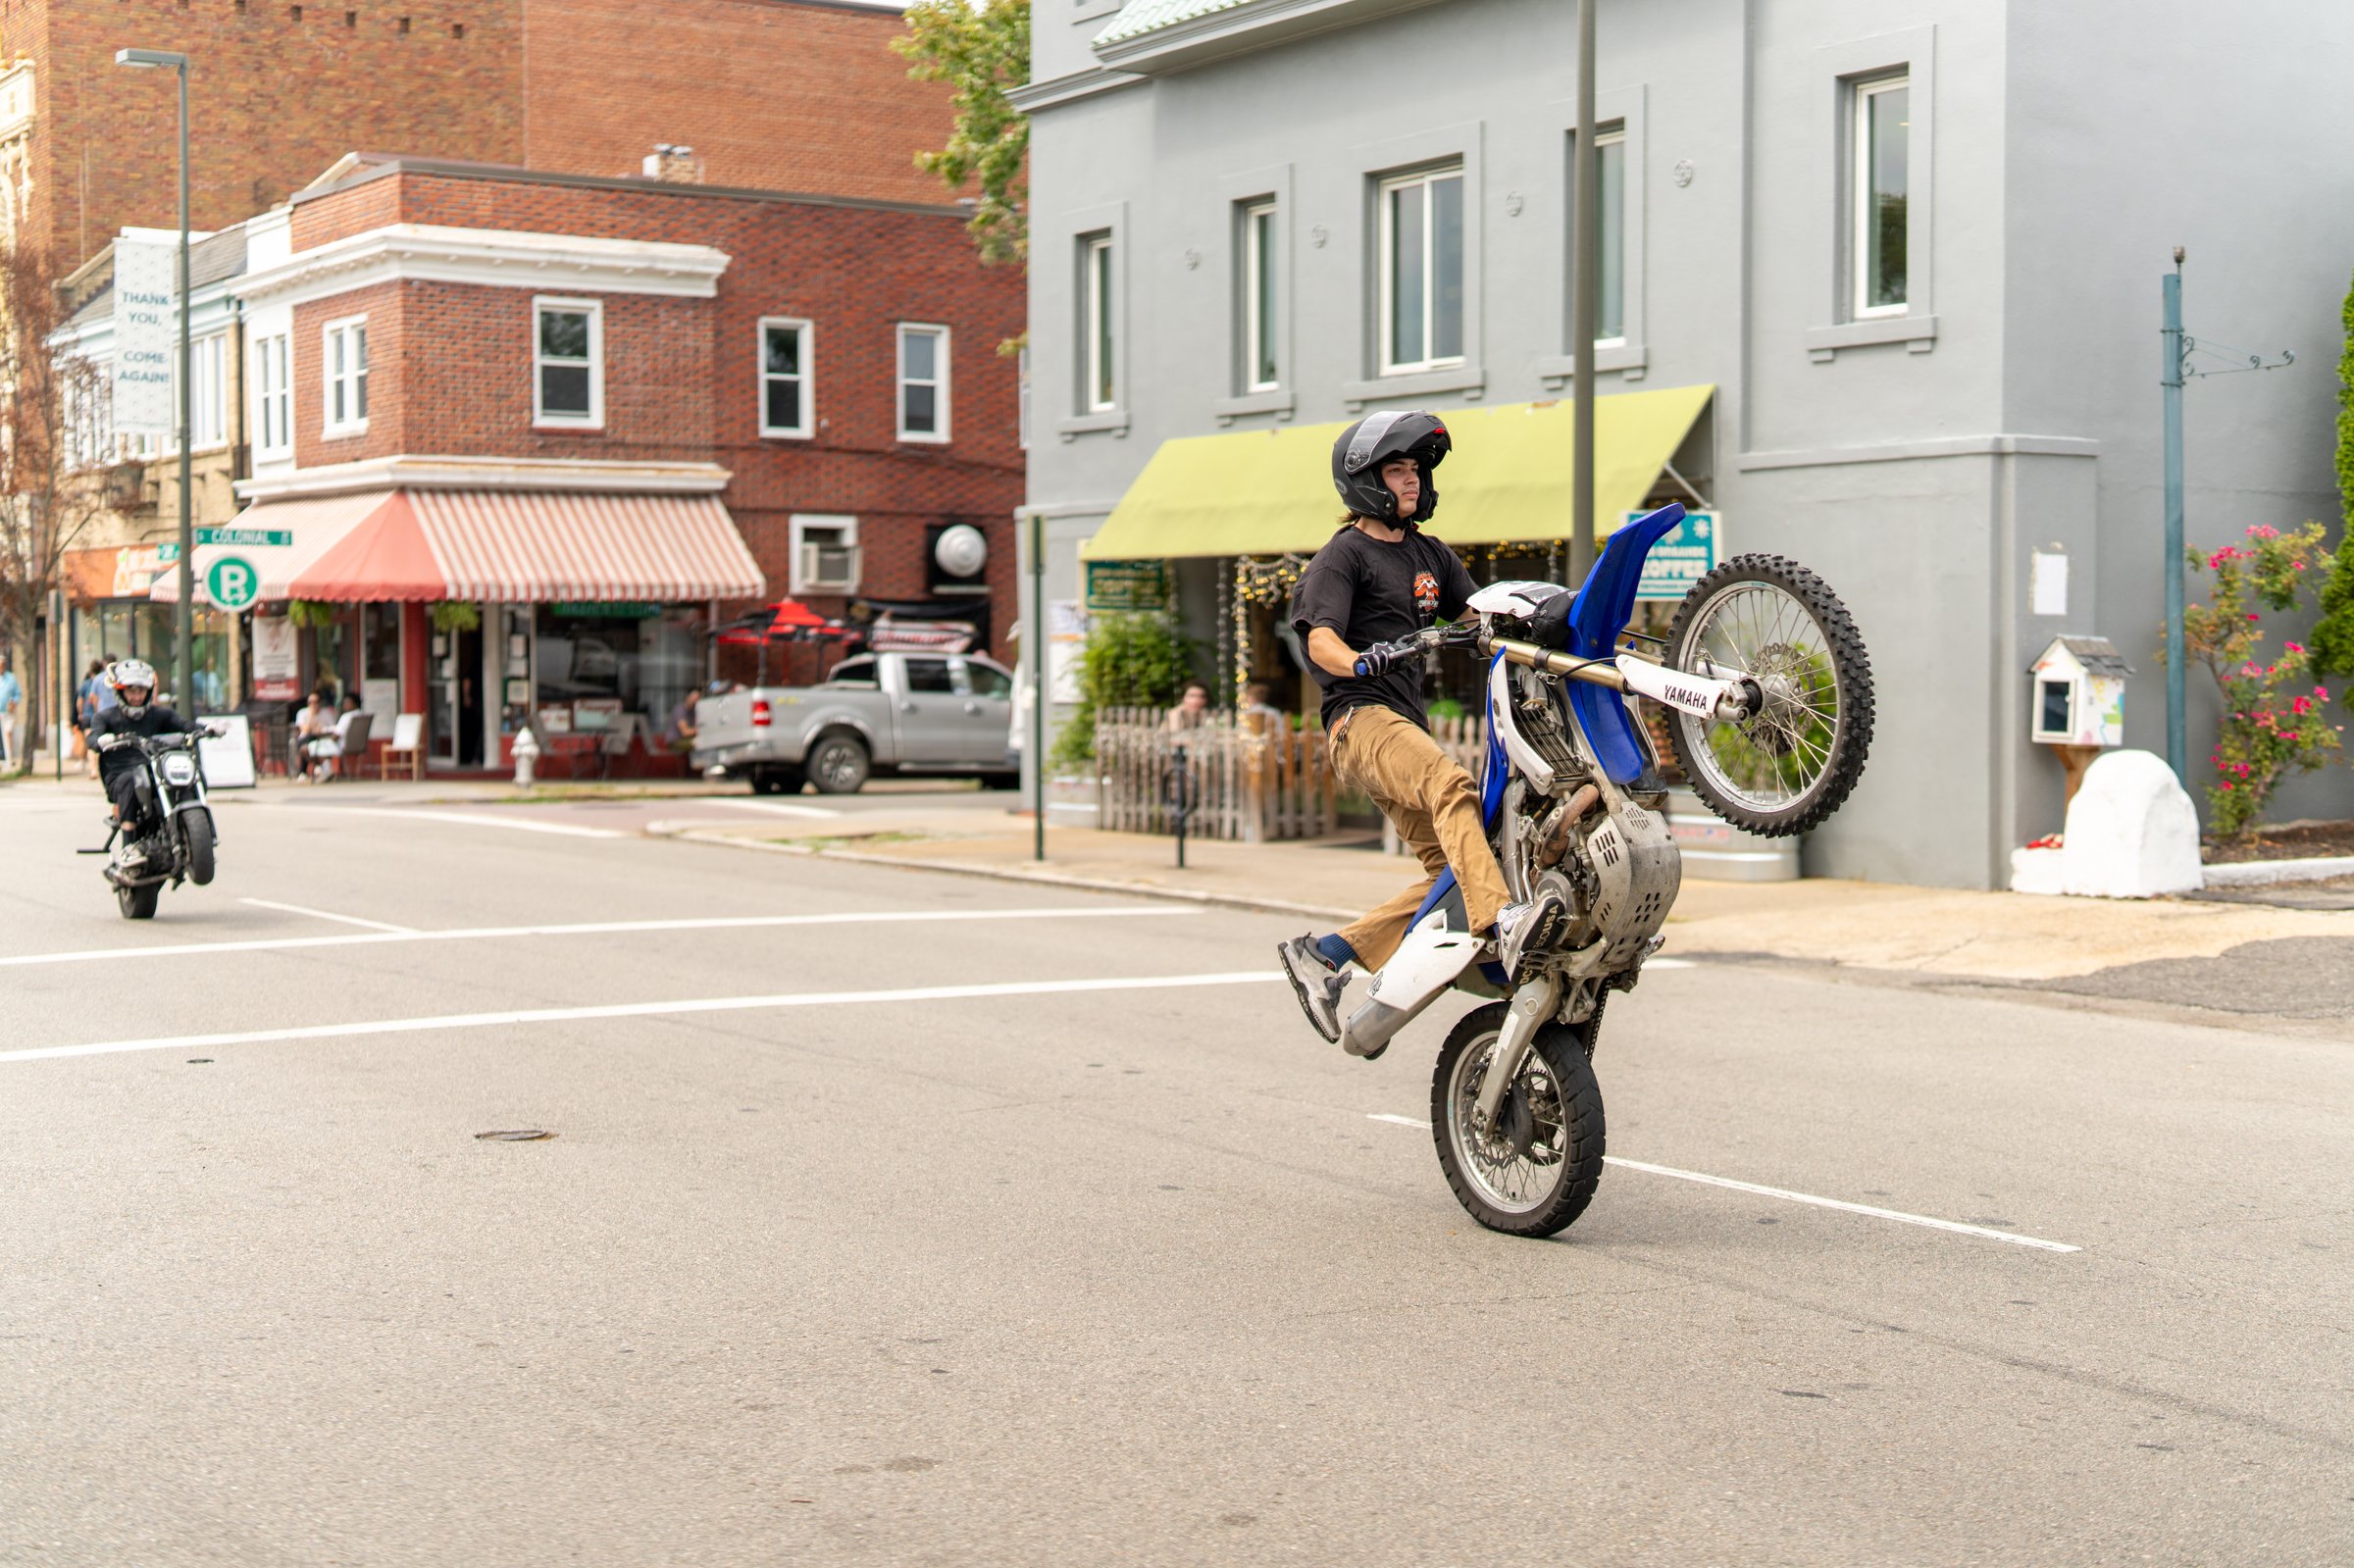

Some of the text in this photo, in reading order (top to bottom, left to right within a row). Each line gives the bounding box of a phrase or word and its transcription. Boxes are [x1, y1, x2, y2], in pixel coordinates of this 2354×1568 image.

[123, 291, 169, 305] THANK
[124, 350, 165, 363] COME
[119, 370, 170, 383] AGAIN!
[211, 530, 273, 544] COLONIAL
[1664, 684, 1707, 710] YAMAHA
